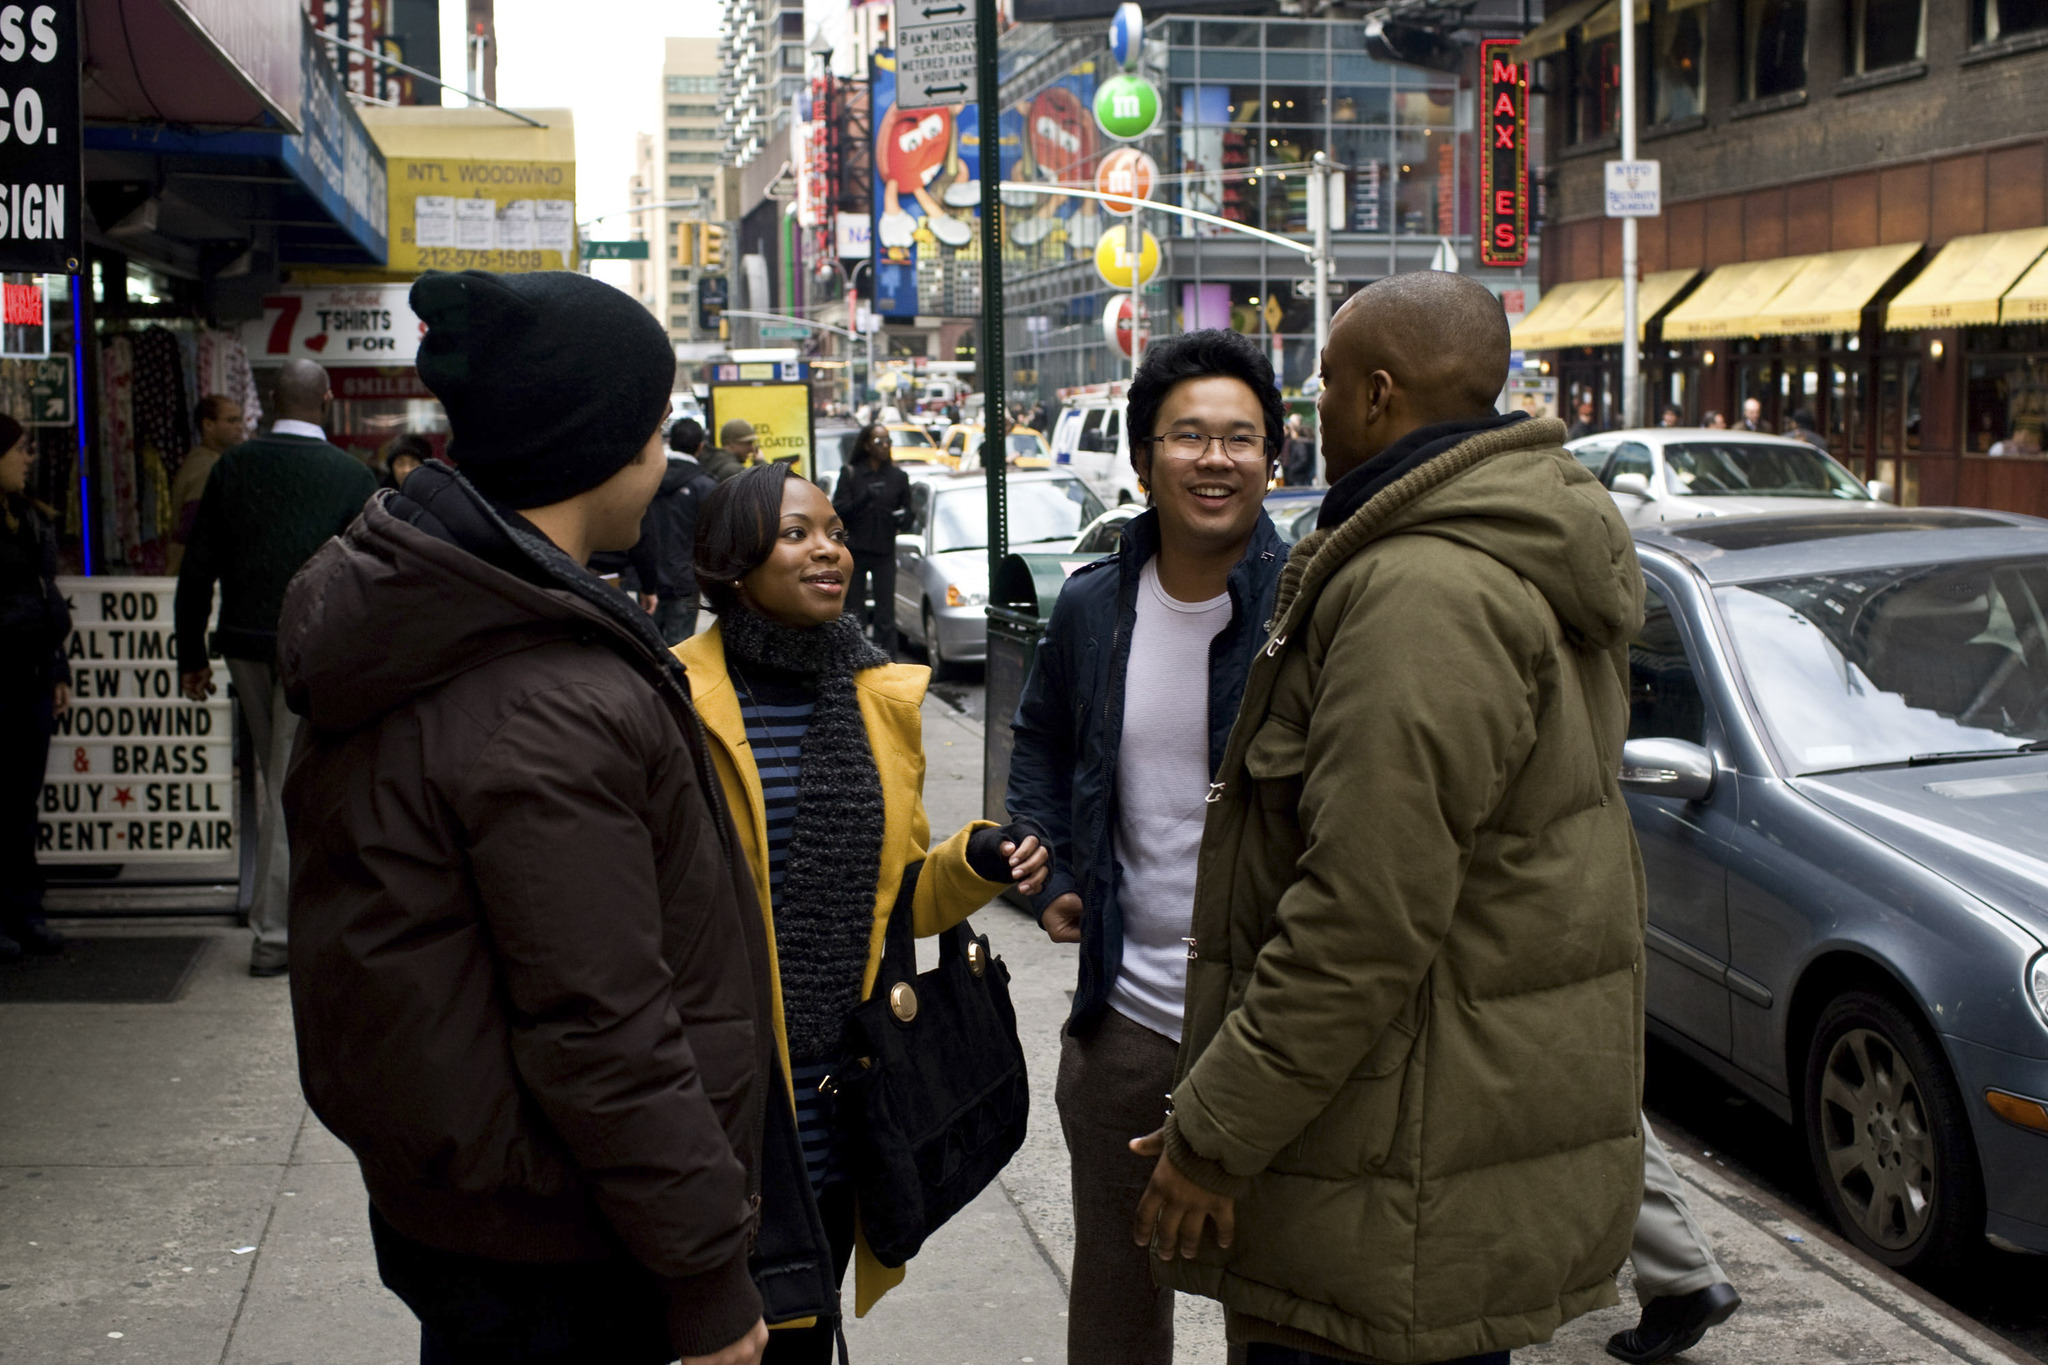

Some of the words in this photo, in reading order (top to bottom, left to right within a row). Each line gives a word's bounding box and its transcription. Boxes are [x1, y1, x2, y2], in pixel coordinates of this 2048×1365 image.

[914, 41, 980, 57] SATURDAY
[901, 57, 946, 71] METERED
[458, 165, 563, 184] WOODWIND
[417, 249, 543, 269] 212-575-1508
[263, 295, 302, 354] 7
[348, 337, 395, 350] FOR
[101, 592, 157, 621] ROD
[51, 706, 212, 736] WOODWIND
[73, 747, 89, 773] &
[113, 745, 208, 774] BRASS
[44, 783, 103, 812] BUY
[146, 783, 220, 812] SELL
